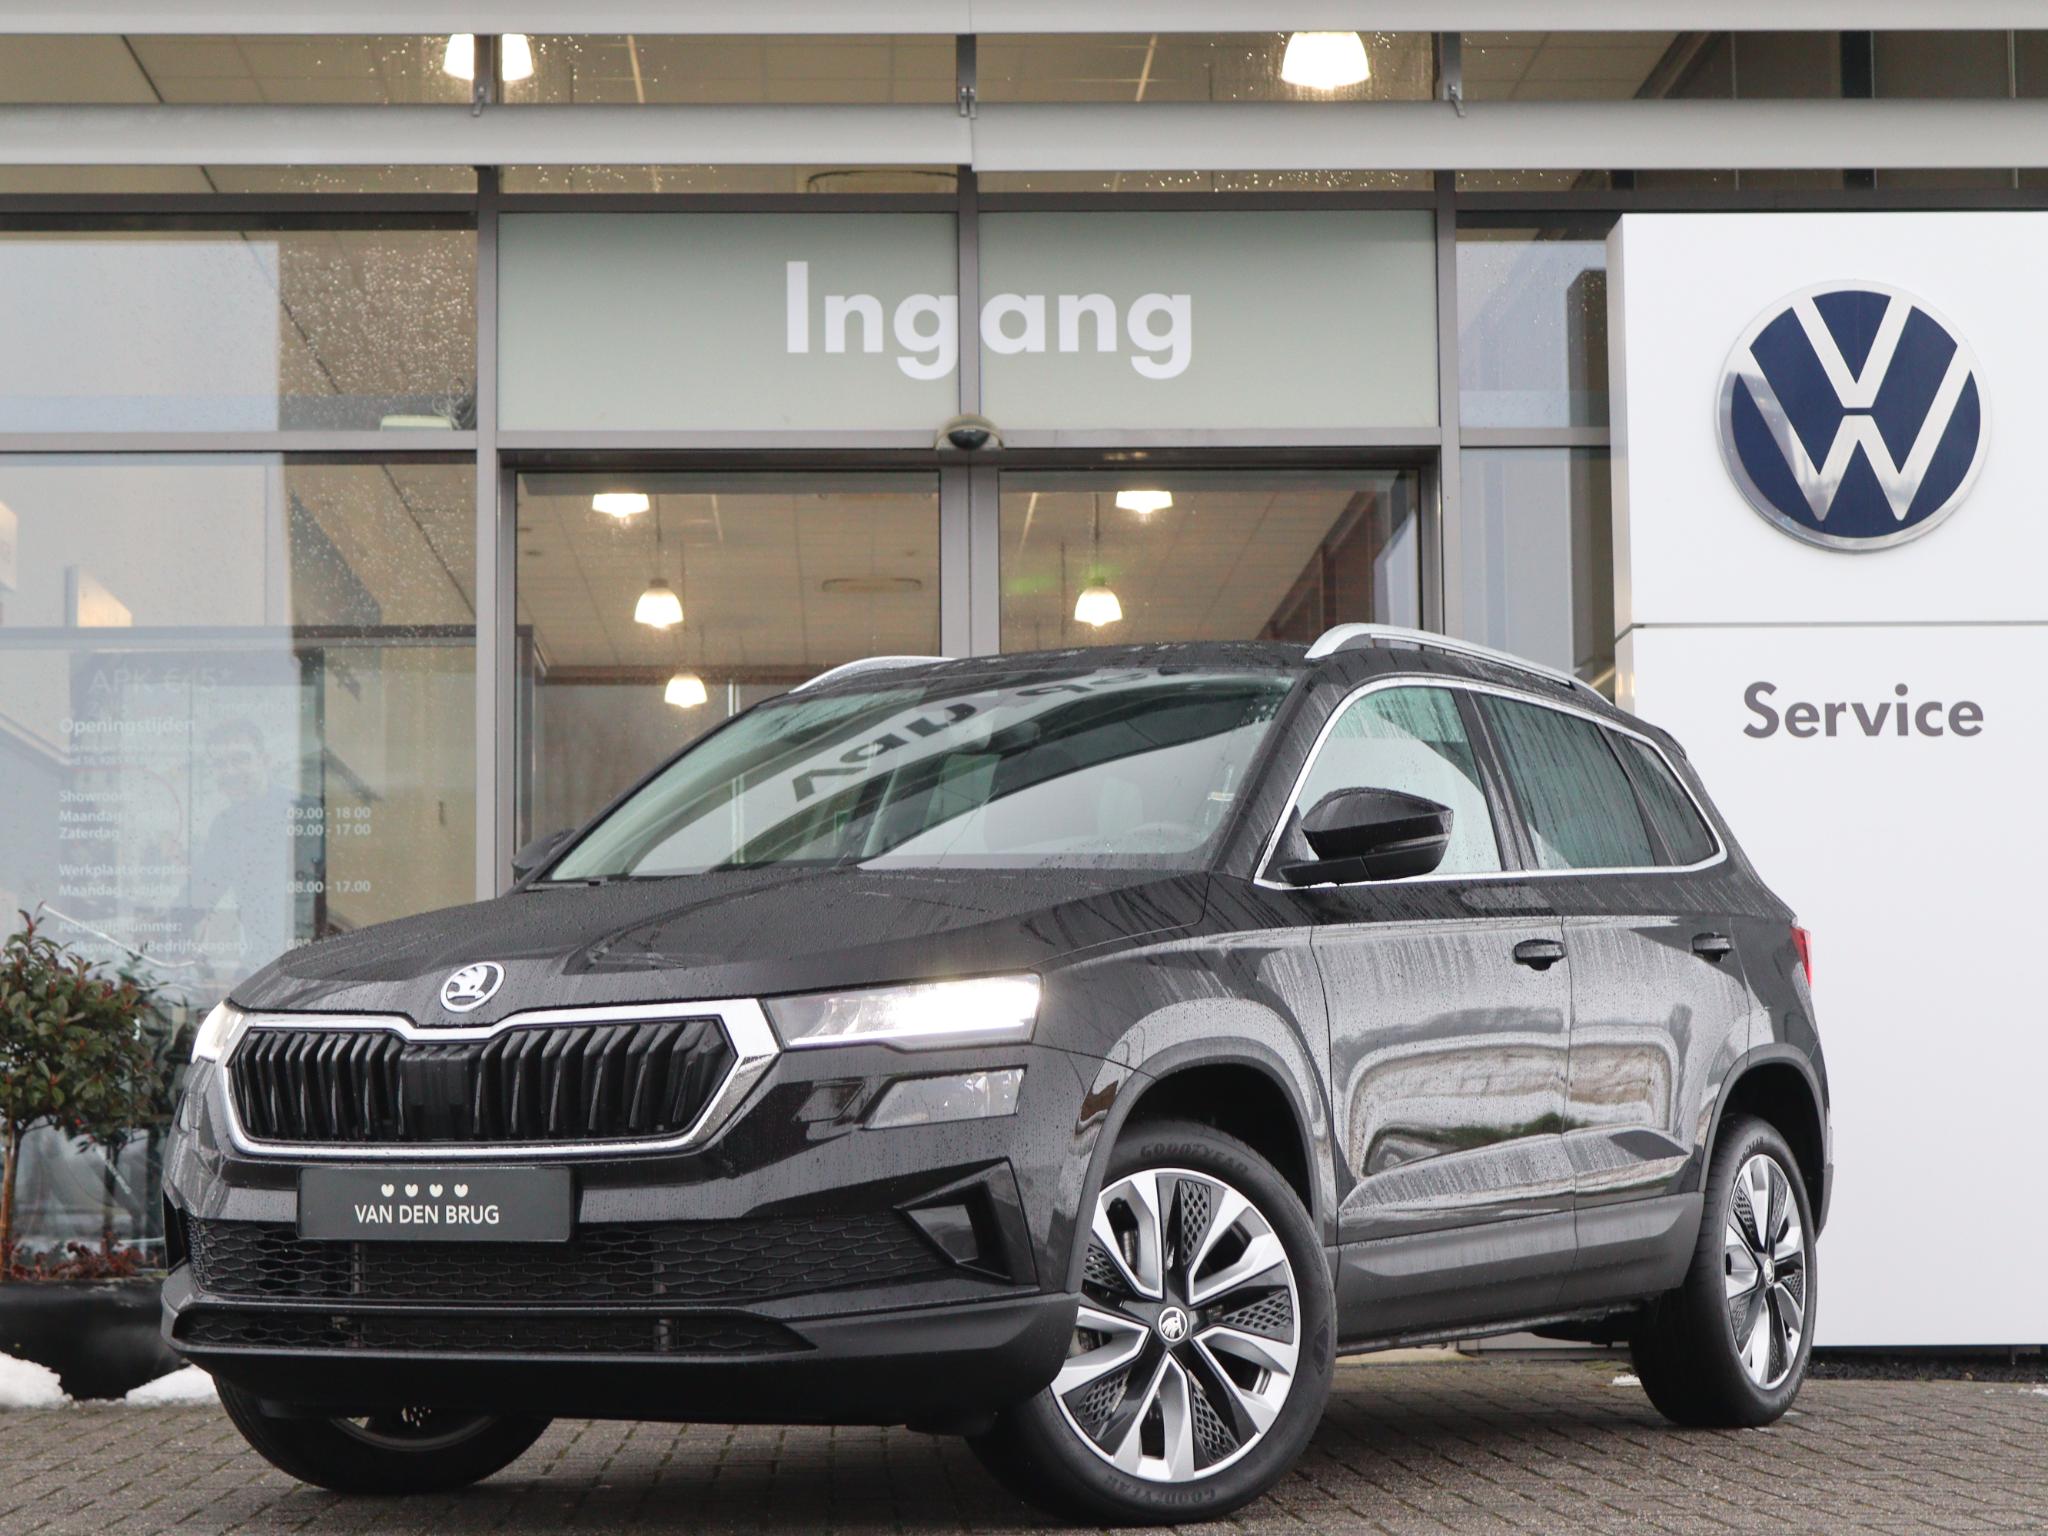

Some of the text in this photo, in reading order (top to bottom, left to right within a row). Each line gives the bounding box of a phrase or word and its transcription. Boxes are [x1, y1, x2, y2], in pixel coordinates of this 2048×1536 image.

[786, 260, 1192, 380] Ingang
[1742, 681, 1984, 739] Service
[58, 715, 195, 737] Openingstijden
[335, 806, 372, 819] 1800
[335, 823, 372, 836] 1700
[335, 880, 372, 893] 17.00
[354, 1204, 500, 1225] VAN DEN BRUG
